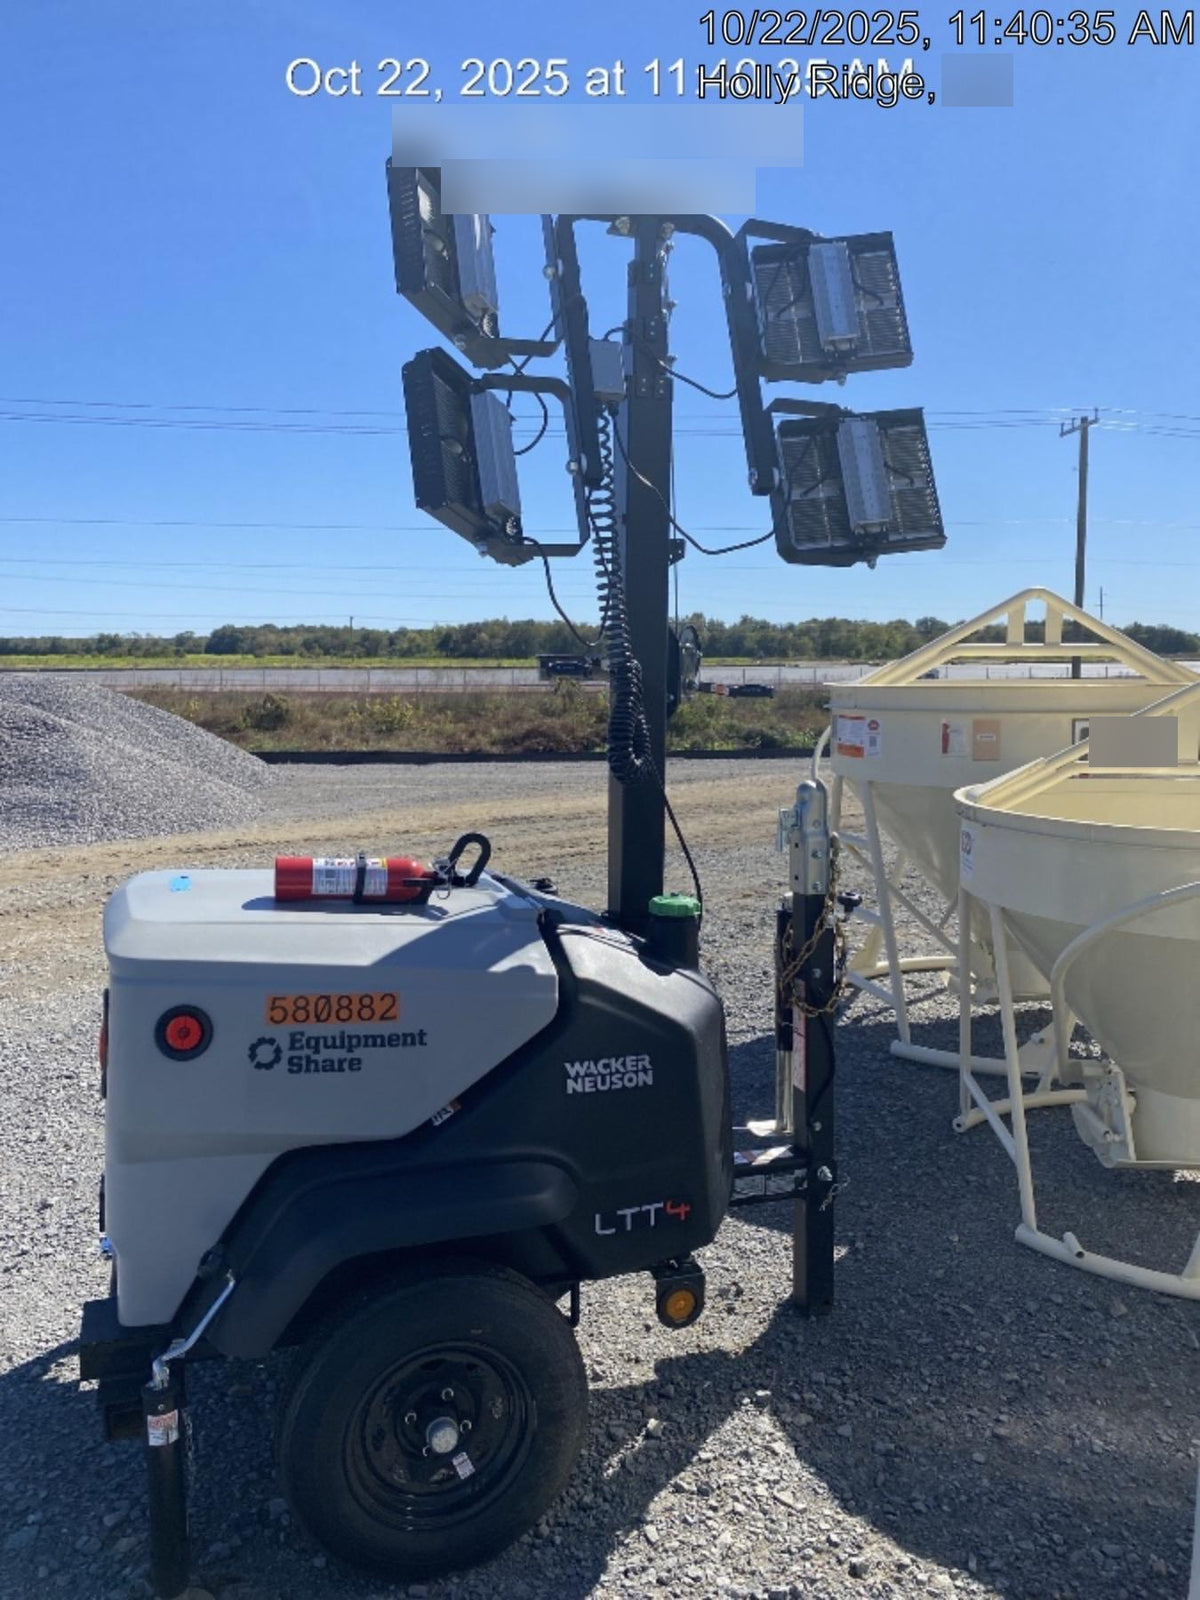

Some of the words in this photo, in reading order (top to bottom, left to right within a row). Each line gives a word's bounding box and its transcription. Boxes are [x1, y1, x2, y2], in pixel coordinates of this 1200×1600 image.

[269, 992, 398, 1025] 580882
[288, 1029, 428, 1054] Equipment
[287, 1054, 362, 1074] Share
[563, 1054, 653, 1078] WACKER
[566, 1069, 654, 1095] NEUSON
